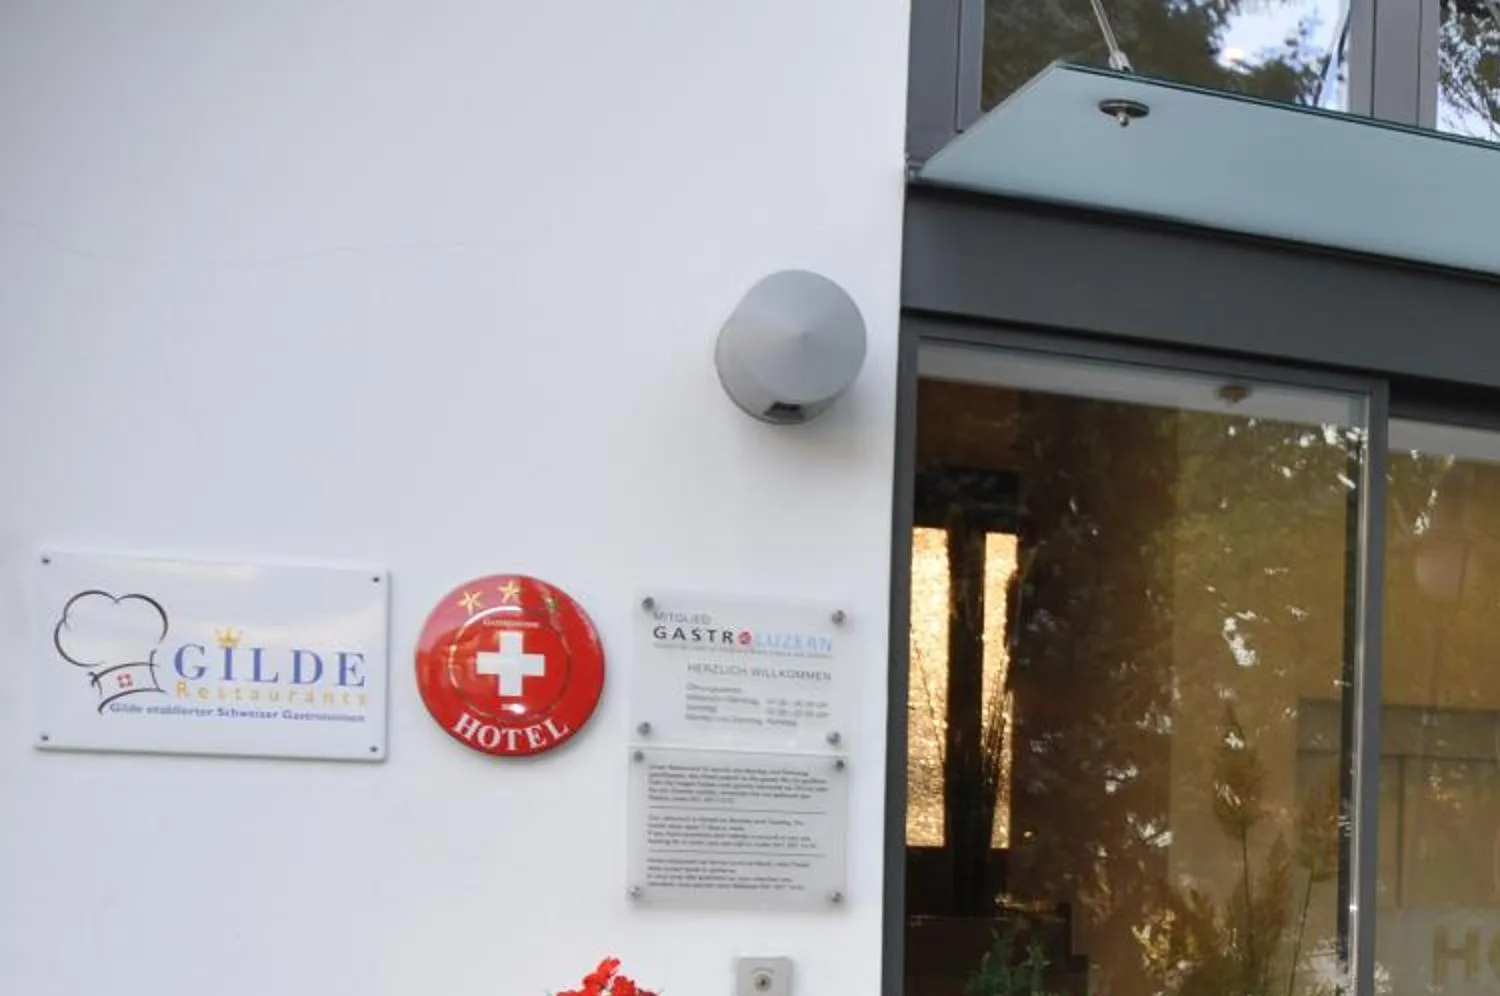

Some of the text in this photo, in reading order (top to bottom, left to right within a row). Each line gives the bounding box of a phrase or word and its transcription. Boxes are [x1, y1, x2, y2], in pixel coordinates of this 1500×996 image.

[174, 643, 366, 687] GILDE
[687, 662, 832, 681] HERZLICH WILLKOMMEN
[176, 680, 367, 704] Restaurants
[217, 707, 279, 719] Schweizer
[452, 712, 569, 751] HOTEL
